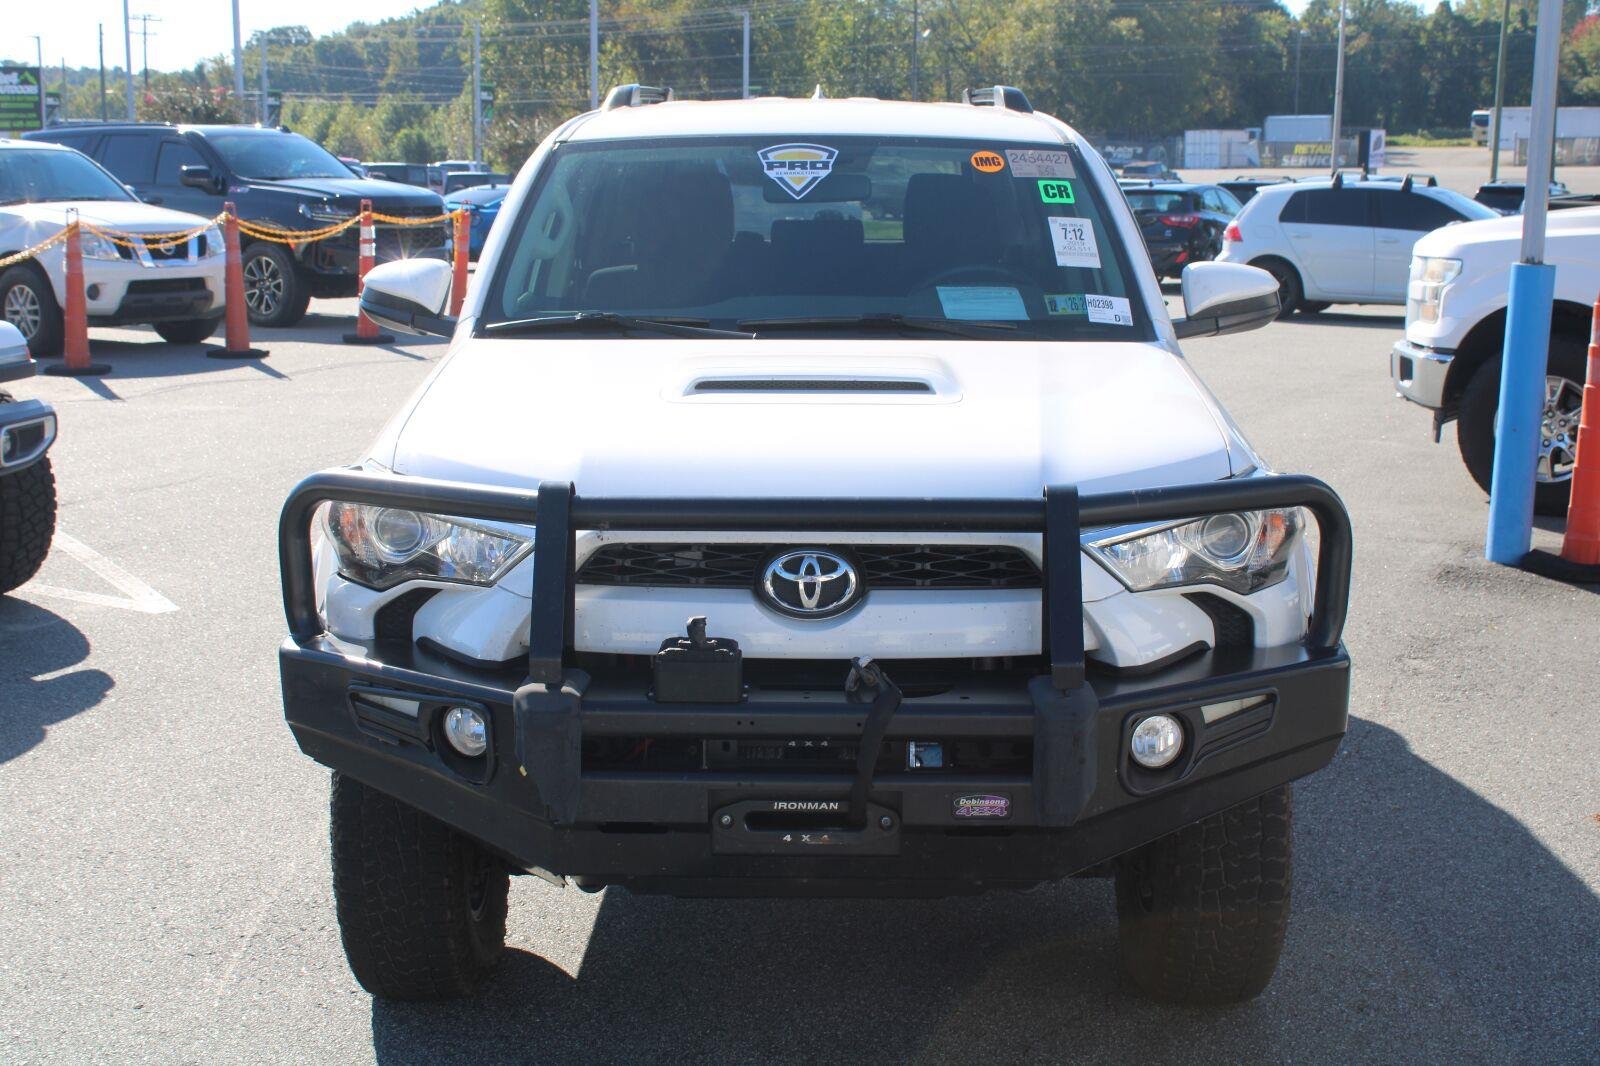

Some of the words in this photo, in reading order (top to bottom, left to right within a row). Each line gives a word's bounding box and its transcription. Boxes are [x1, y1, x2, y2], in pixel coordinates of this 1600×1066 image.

[764, 160, 831, 171] PRO
[974, 156, 1002, 167] IMG
[1281, 154, 1347, 167] SERVICS
[1042, 183, 1072, 199] CR
[1061, 227, 1085, 241] 7:12
[773, 801, 839, 810] IRONMAN
[959, 798, 1006, 806] Dobinsons
